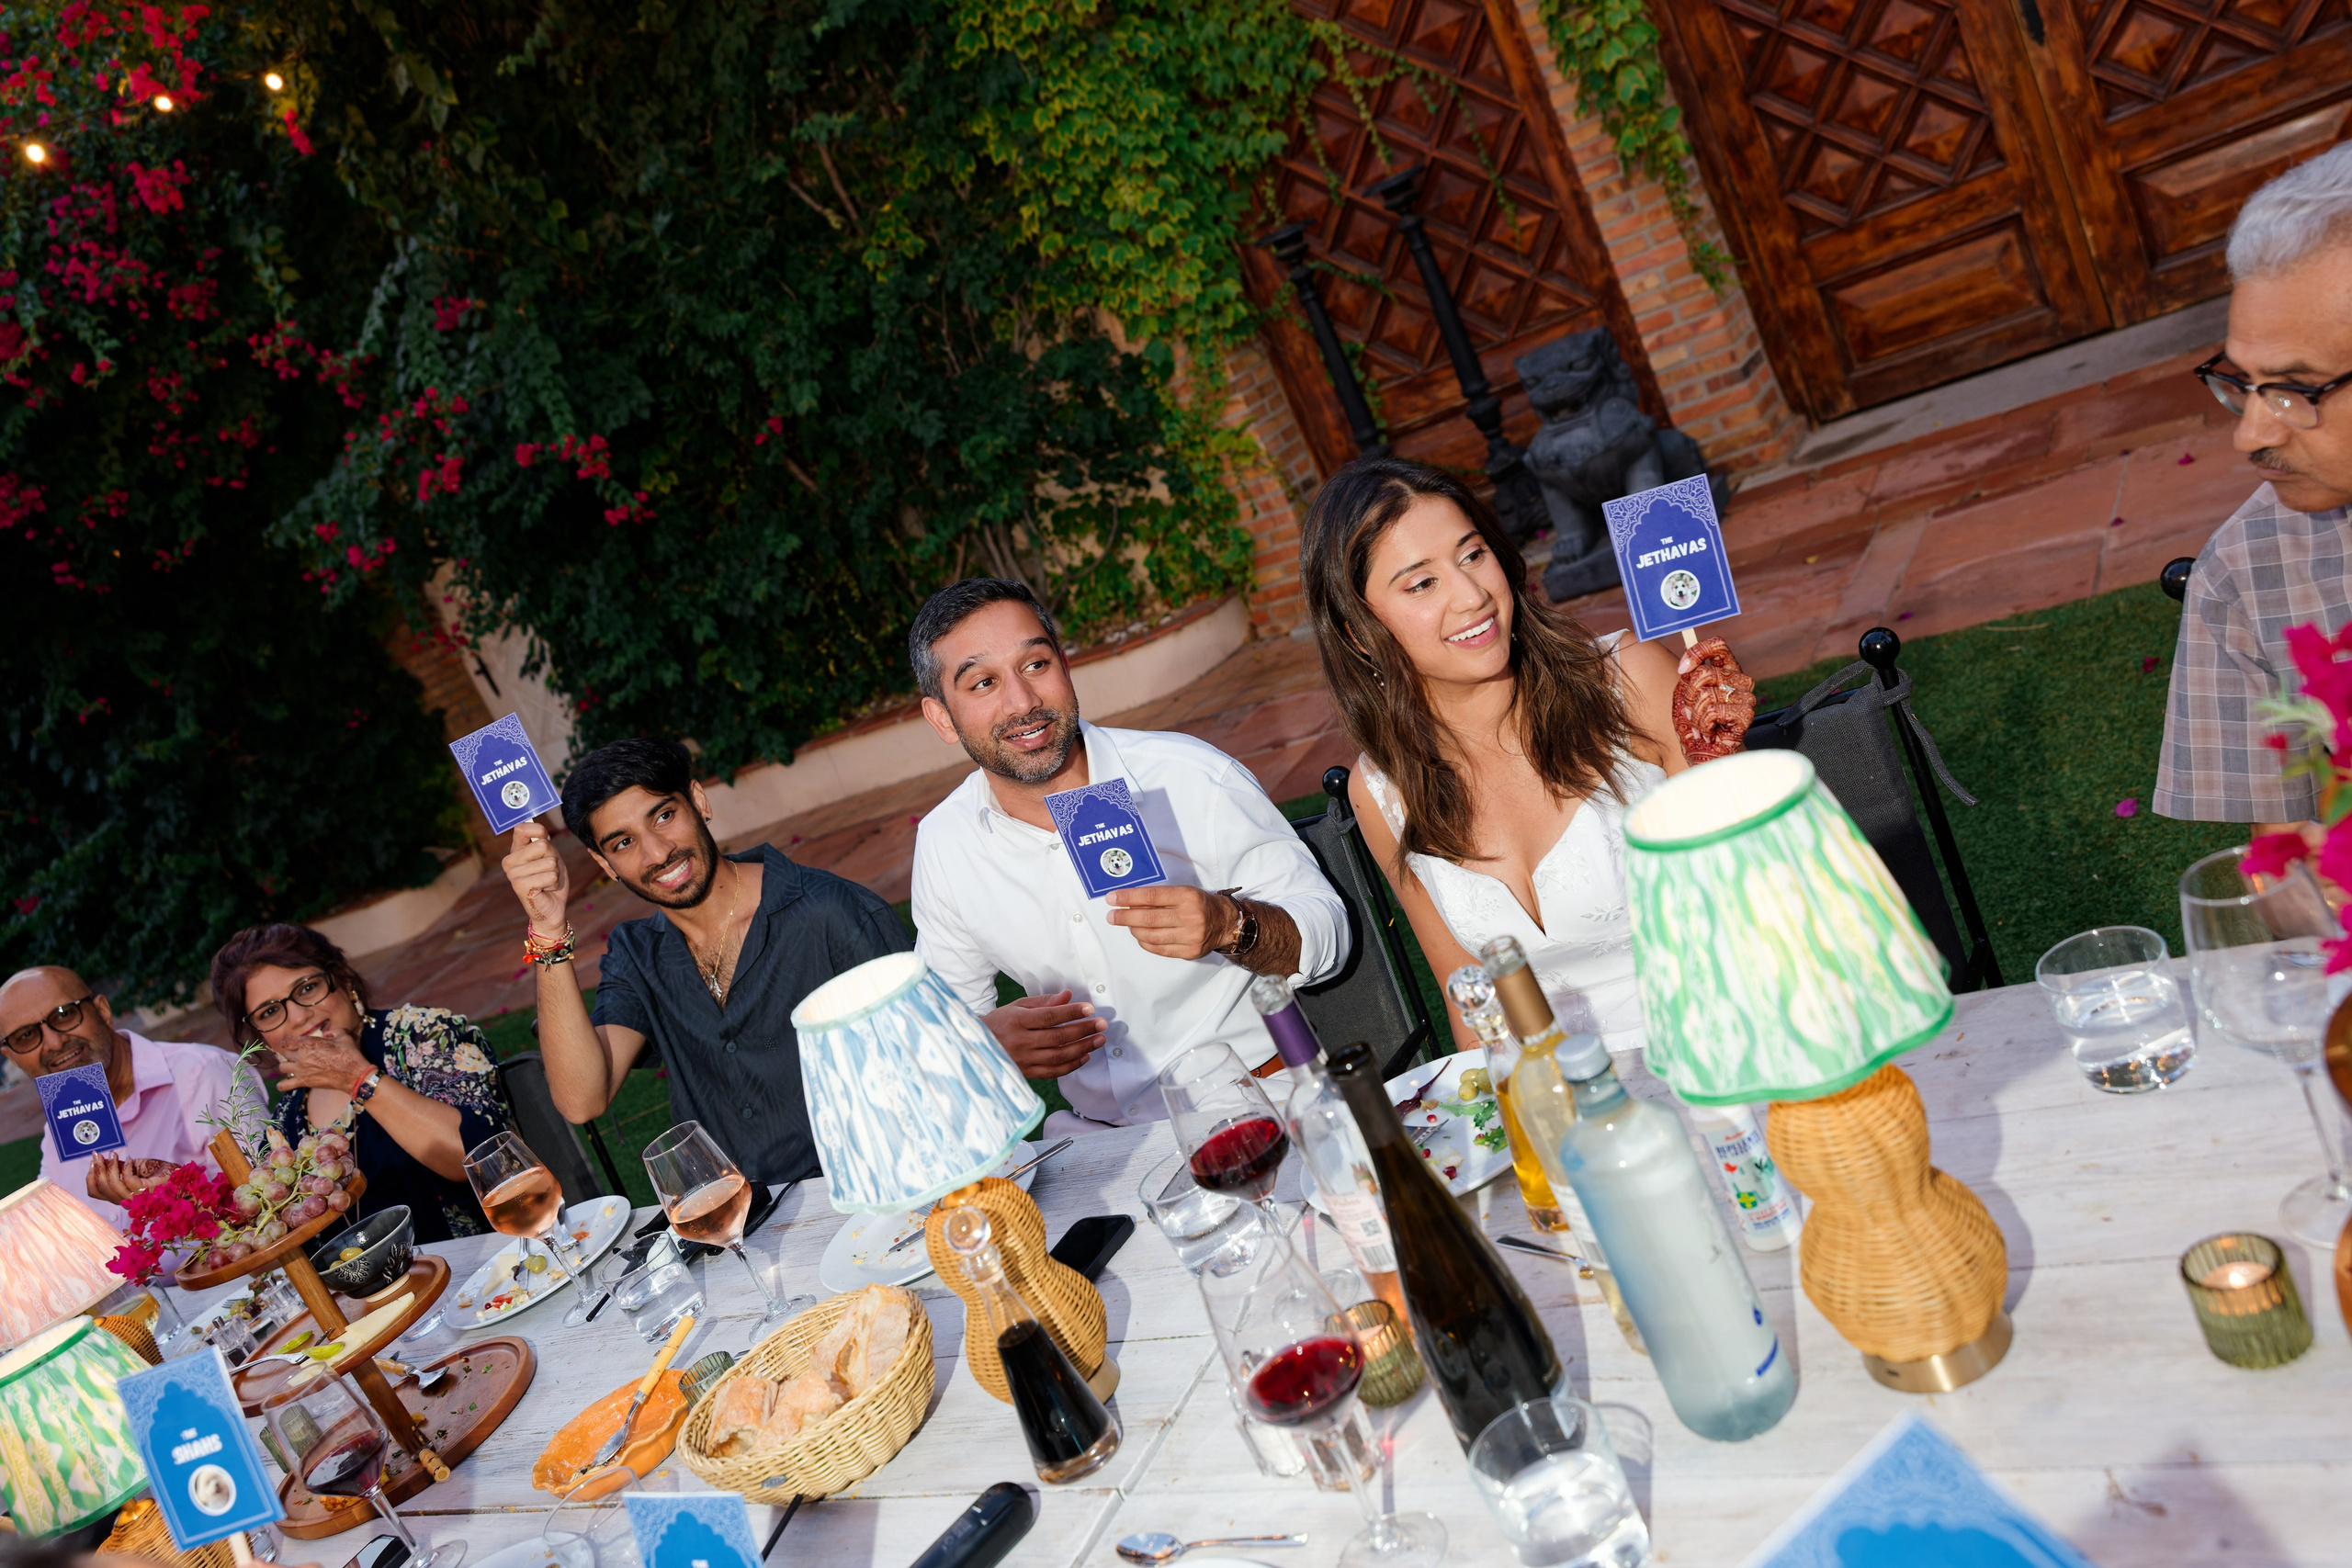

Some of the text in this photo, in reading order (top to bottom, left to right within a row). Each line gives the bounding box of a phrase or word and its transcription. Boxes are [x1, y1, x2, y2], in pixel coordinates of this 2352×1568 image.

[1660, 536, 1673, 545] THE
[1636, 537, 1707, 569] JETHAVAS
[481, 756, 527, 785] JETHAVAS
[1078, 823, 1134, 847] JETHAVAS
[57, 1100, 104, 1120] JETHAVAS
